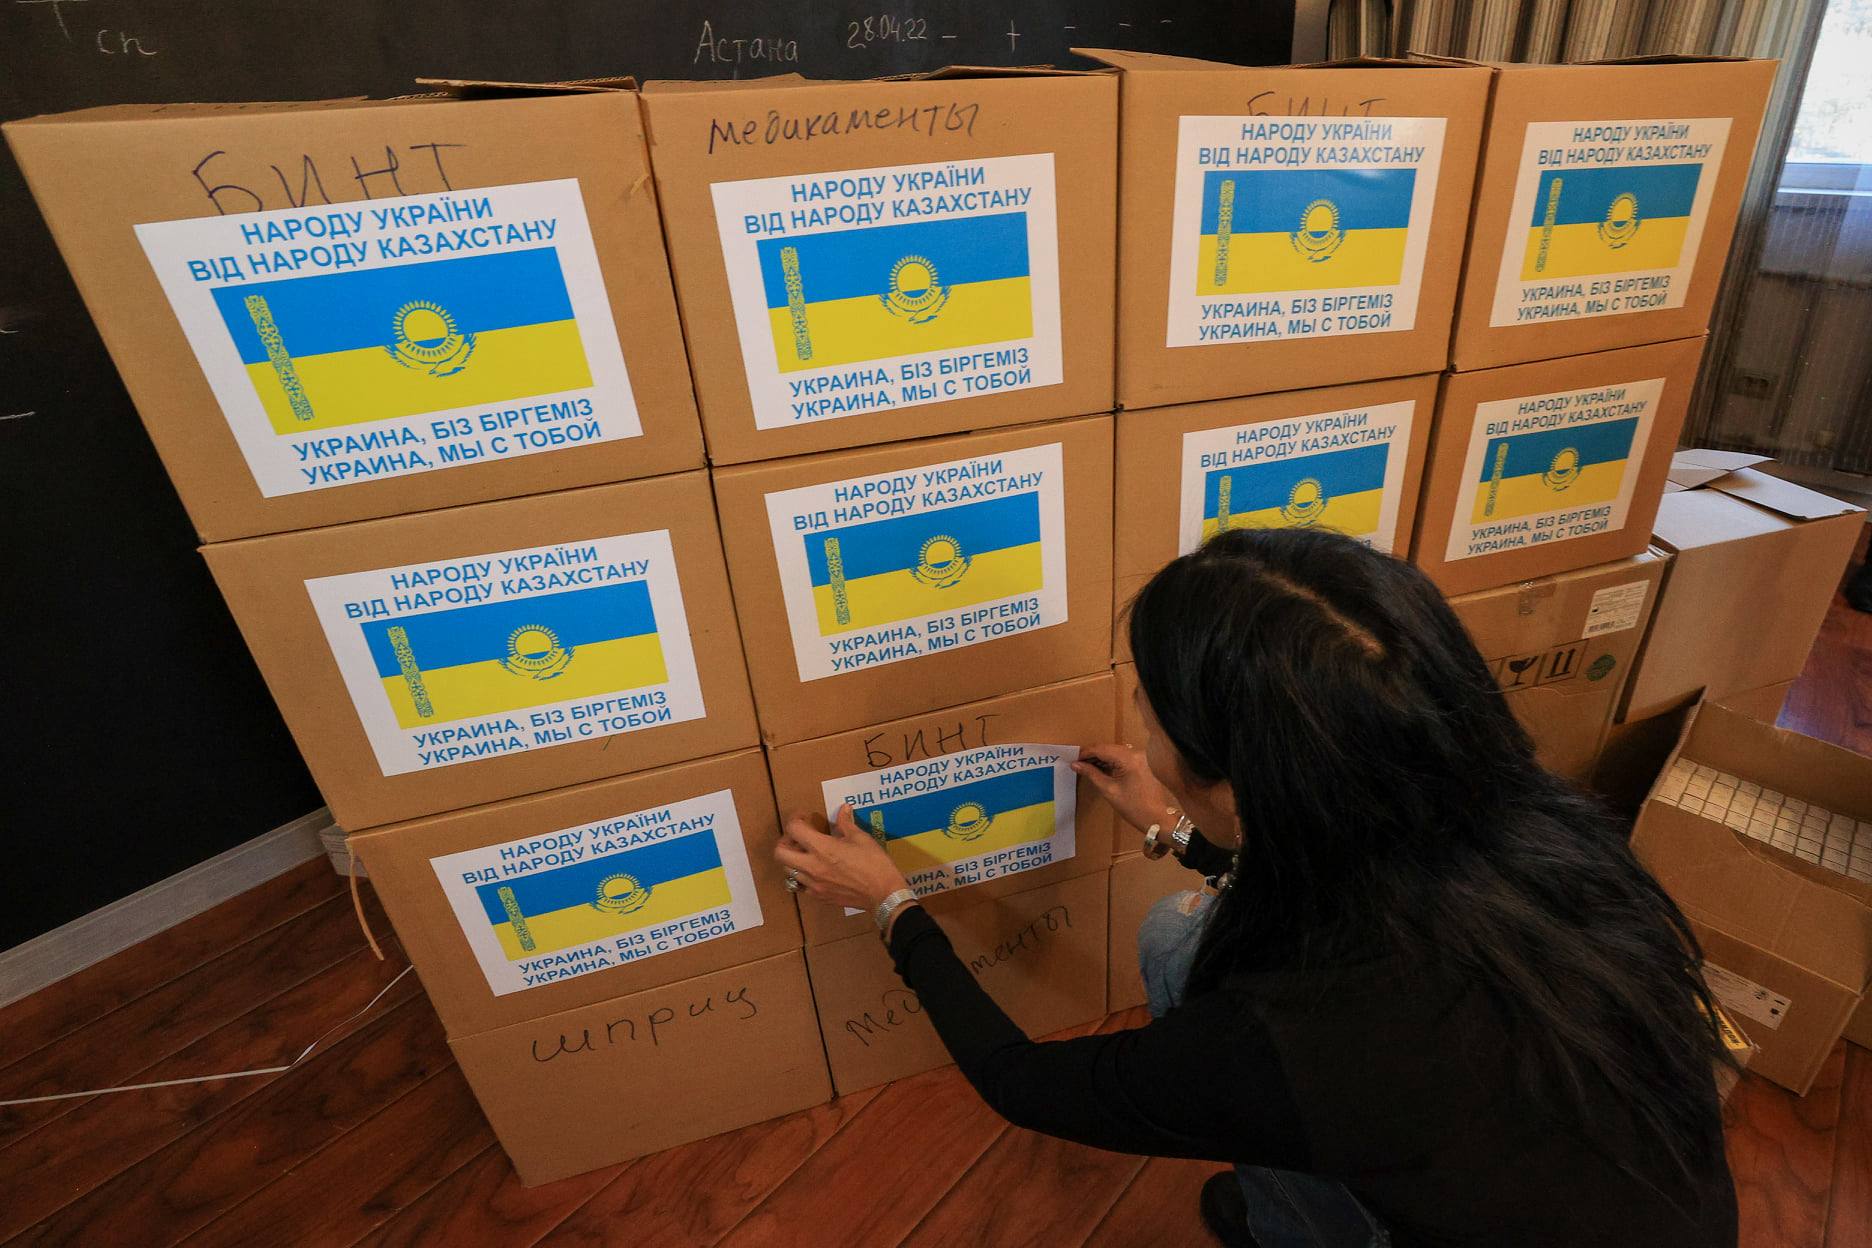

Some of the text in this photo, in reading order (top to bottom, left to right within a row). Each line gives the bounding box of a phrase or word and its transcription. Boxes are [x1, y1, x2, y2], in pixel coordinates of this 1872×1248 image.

[694, 20, 798, 65] Астана
[847, 18, 928, 49] 28.04.22
[1241, 120, 1392, 144] НАРОДУ УКРАЇНИ
[1536, 143, 1713, 167] ВІД НАРОДУ КАЗАХСТАНУ
[1572, 121, 1691, 144] НАРОДУ УКРАЇНИ
[192, 143, 467, 216] БИНТ
[1198, 146, 1425, 168] ВІД НАРОДУ КАЗАХСТАНУ
[790, 164, 985, 203] НАРОДУ УКРАЇНИ
[240, 196, 494, 246] НАРОДУ УКРАЇНИ
[743, 187, 1032, 236] ВІД НАРОДУ КАЗАХСТАНУ
[186, 218, 557, 283] ВІД НАРОДУ КАЗАХСТАНУ
[1201, 293, 1394, 321] УКРАИНА, БІЗ БІРГЕМІЗ
[1516, 289, 1668, 322] УКРАИНА, МЫ С ТОБОЙ
[1521, 274, 1671, 303] УКРАИНА, БІЗ БІРГЕМІЗ
[1199, 310, 1392, 341] УКРАИНА, МЫ С ТОБОЙ
[788, 347, 1029, 398] УКРАИНА, БІЗ БІРГЕМІЗ
[791, 364, 1031, 420] УКРАИНА, МЫ С ТОБОЙ
[1485, 400, 1648, 437] ВІД НАРОДУ КАЗАХСТАНУ
[1517, 387, 1627, 416] НАРОДУ УКРАЇНИ
[291, 398, 593, 462] УКРАИНА, БІЗ БІРГЕМІЗ
[300, 417, 602, 486] УКРАИНА, МЫ С ТОБОЙ
[1201, 425, 1397, 468] ВІД НАРОДУ КАЗАХСТАНУ
[1236, 413, 1368, 445] НАРОДУ УКРАЇНИ
[792, 471, 1043, 531] ВІД НАРОДУ КАЗАХСТАНУ
[833, 459, 1003, 503] НАРОДУ УКРАЇНИ
[1530, 529, 1554, 544] МЫ
[1555, 527, 1566, 539] С
[1567, 517, 1609, 537] ТОБОЙ
[1535, 515, 1556, 530] БІЗ
[1557, 505, 1612, 526] БІРГЕМІЗ
[344, 559, 649, 619] ВІД НАРОДУ КАЗАХСТАНУ
[390, 545, 598, 591] НАРОДУ УКРАЇНИ
[828, 597, 1040, 655] УКРАИНА, БІЗ БІРГЕМІЗ
[830, 611, 1041, 672] УКРАИНА, МЫ С ТОБОЙ
[412, 690, 667, 749] УКРАИНА, БІЗ БІРГЕМІЗ
[417, 704, 672, 766] УКРАИНА, МЫ С ТОБОЙ
[864, 714, 1001, 768] БИНТ
[845, 755, 1060, 806] ВІД НАРОДУ КАЗАХСТАНУ
[880, 746, 1024, 786] НАРОДУ УКРАЇНИ
[461, 813, 715, 885] ВІД НАРОДУ КАЗАХСТАНУ
[499, 809, 672, 861] НАРОДУ УКРАЇНИ
[954, 861, 978, 875] БІЗ
[983, 842, 1051, 868] БІРГЕМІЗ
[954, 872, 981, 887] МЫ
[986, 868, 996, 879] С
[1000, 852, 1053, 876] ТОБОЙ
[518, 909, 731, 975] УКРАИНА, БІЗ БІРГЕМІЗ
[522, 919, 736, 987] УКРАИНА, МЫ С ТОБОЙ
[532, 987, 757, 1062] шприц
